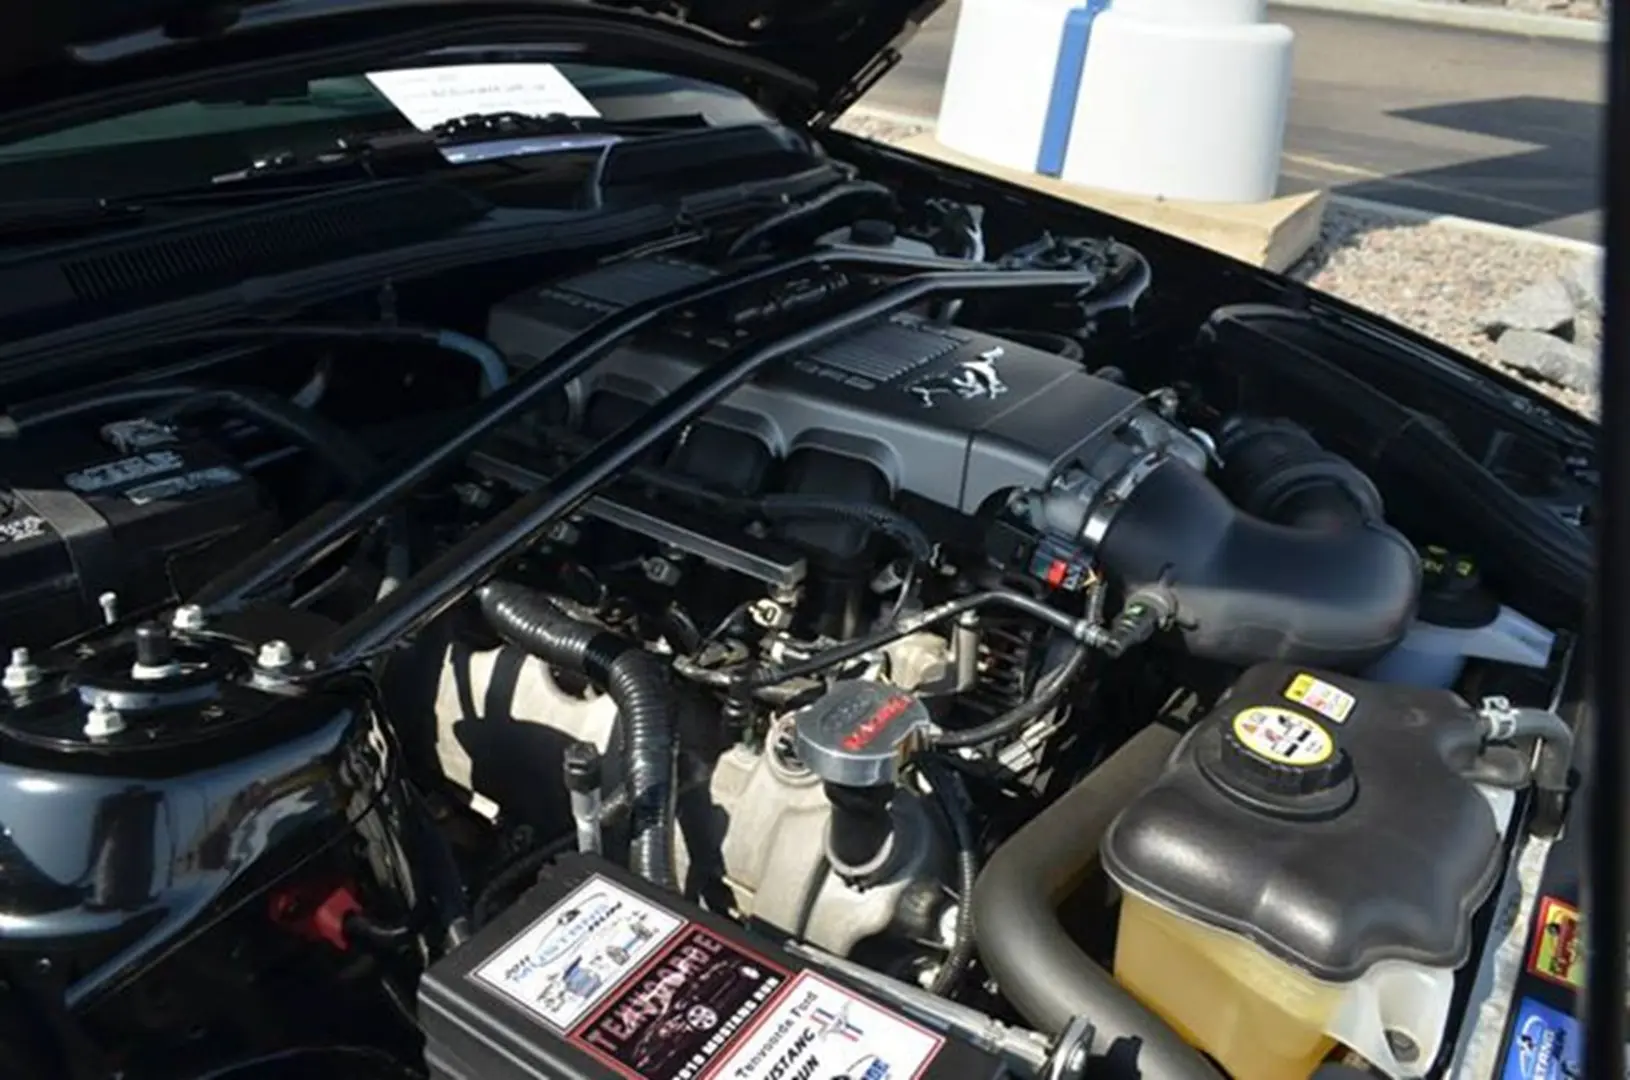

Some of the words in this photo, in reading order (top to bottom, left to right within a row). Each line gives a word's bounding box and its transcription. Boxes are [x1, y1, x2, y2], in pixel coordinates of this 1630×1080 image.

[701, 999, 759, 1056] MUSTANG
[734, 1016, 796, 1078] Tenvoorde
[790, 989, 820, 1019] Ford
